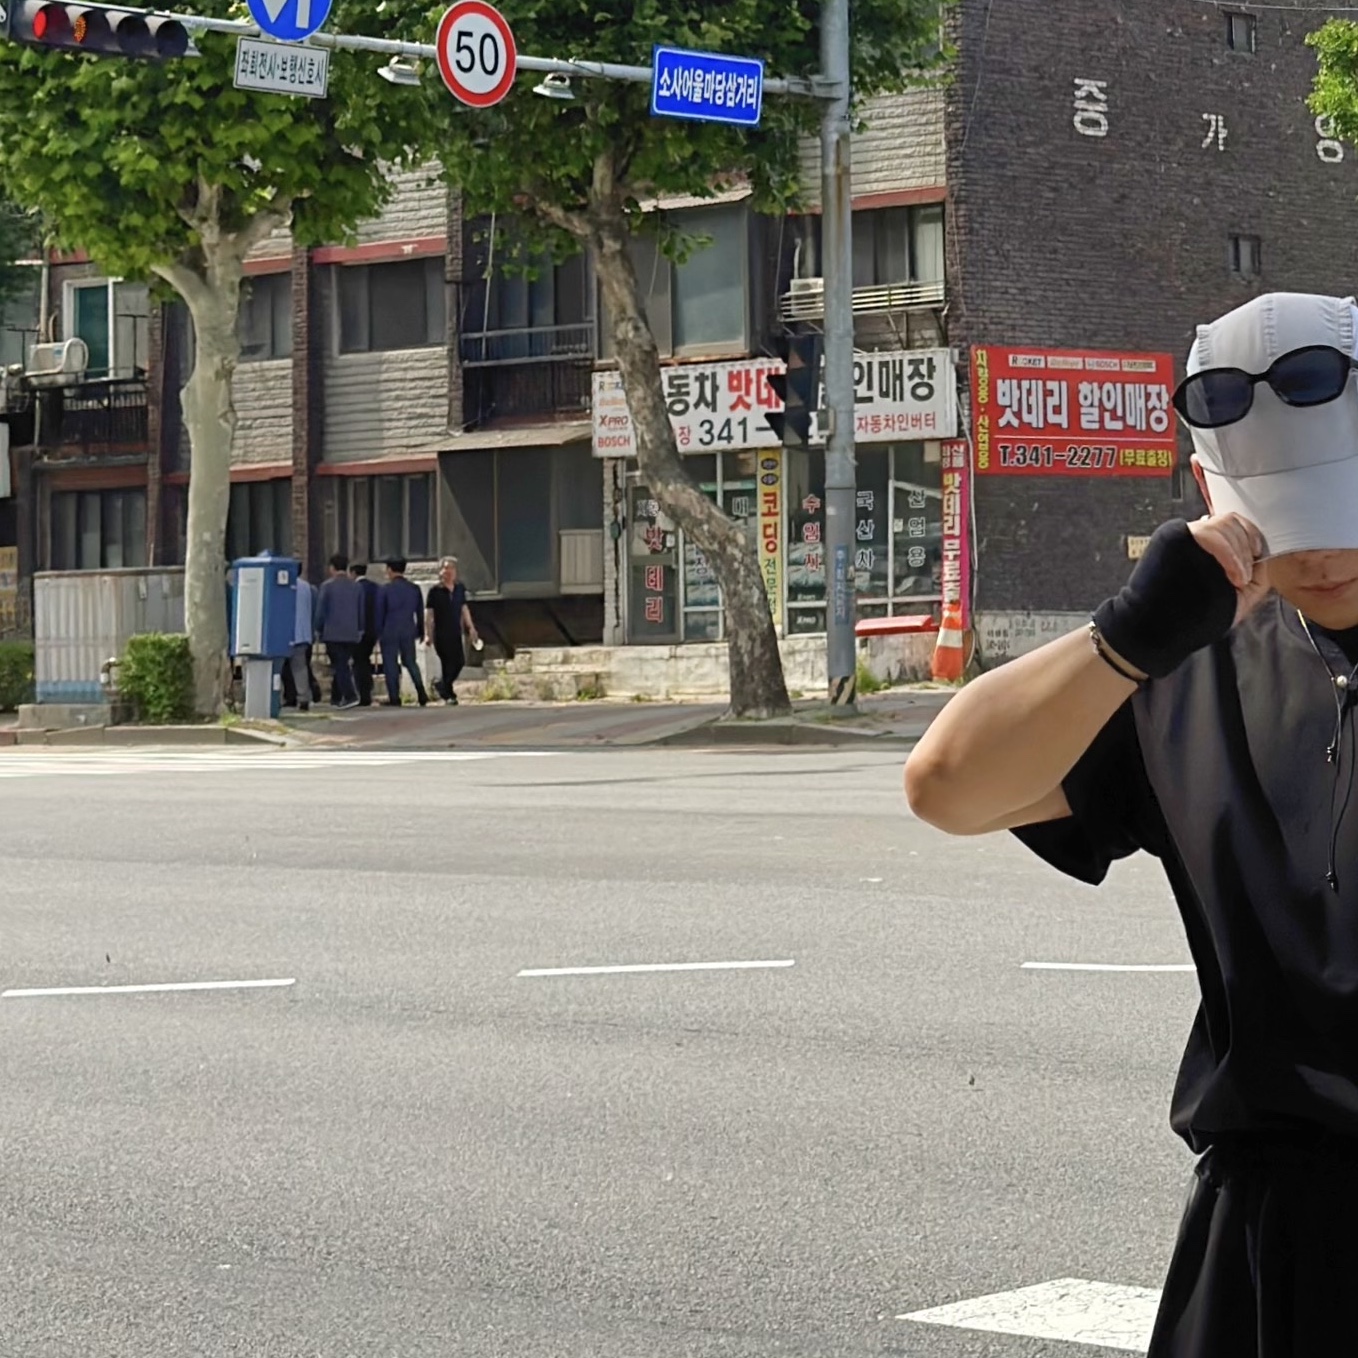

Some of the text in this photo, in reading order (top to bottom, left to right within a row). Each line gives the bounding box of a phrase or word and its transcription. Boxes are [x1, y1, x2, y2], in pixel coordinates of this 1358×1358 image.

[456, 30, 499, 76] 50
[658, 65, 759, 110] 소사어울마당삼거리
[666, 371, 719, 416] 동차
[853, 357, 936, 403] 인매장
[996, 378, 1169, 432] 밧데리 할인매장
[598, 435, 631, 448] BOSCH
[857, 412, 937, 434] 자동차인버터
[998, 443, 1118, 468] T.341-2277
